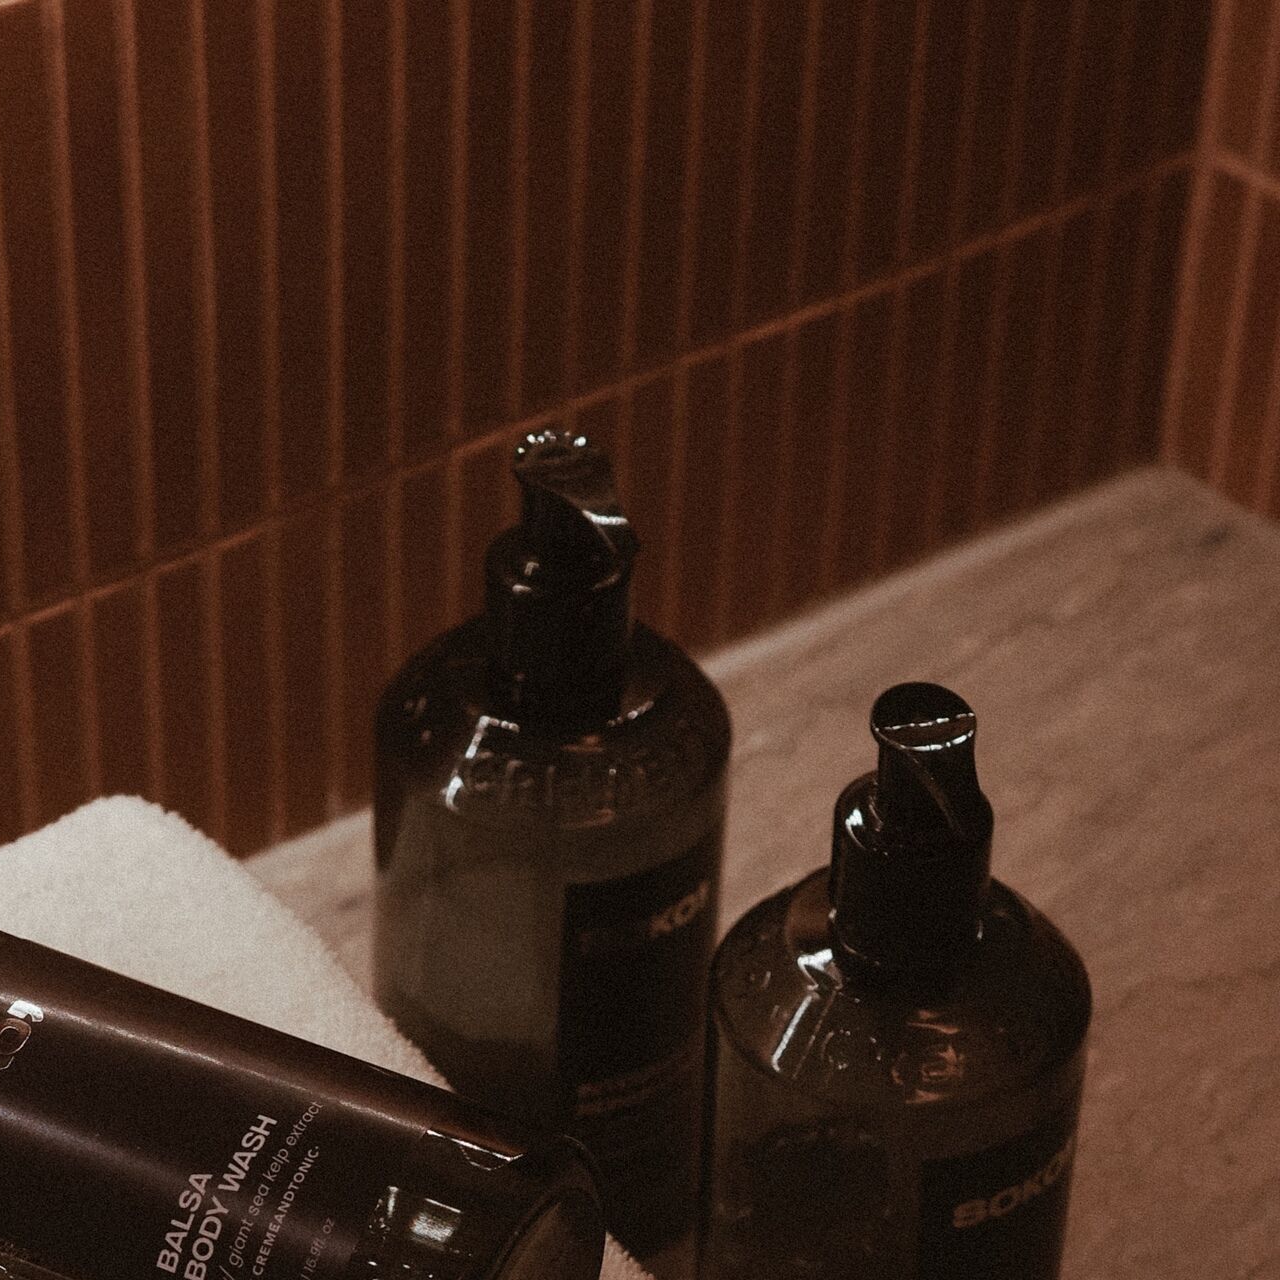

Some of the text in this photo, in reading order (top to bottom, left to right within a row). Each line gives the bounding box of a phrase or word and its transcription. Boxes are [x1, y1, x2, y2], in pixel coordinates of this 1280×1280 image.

[217, 1114, 278, 1191] WASH
[229, 1218, 254, 1269] giant
[248, 1183, 270, 1216] sea
[263, 1147, 289, 1182] kelp
[286, 1100, 323, 1146] extract
[156, 1173, 213, 1274] BALSA
[323, 1217, 335, 1234] oz
